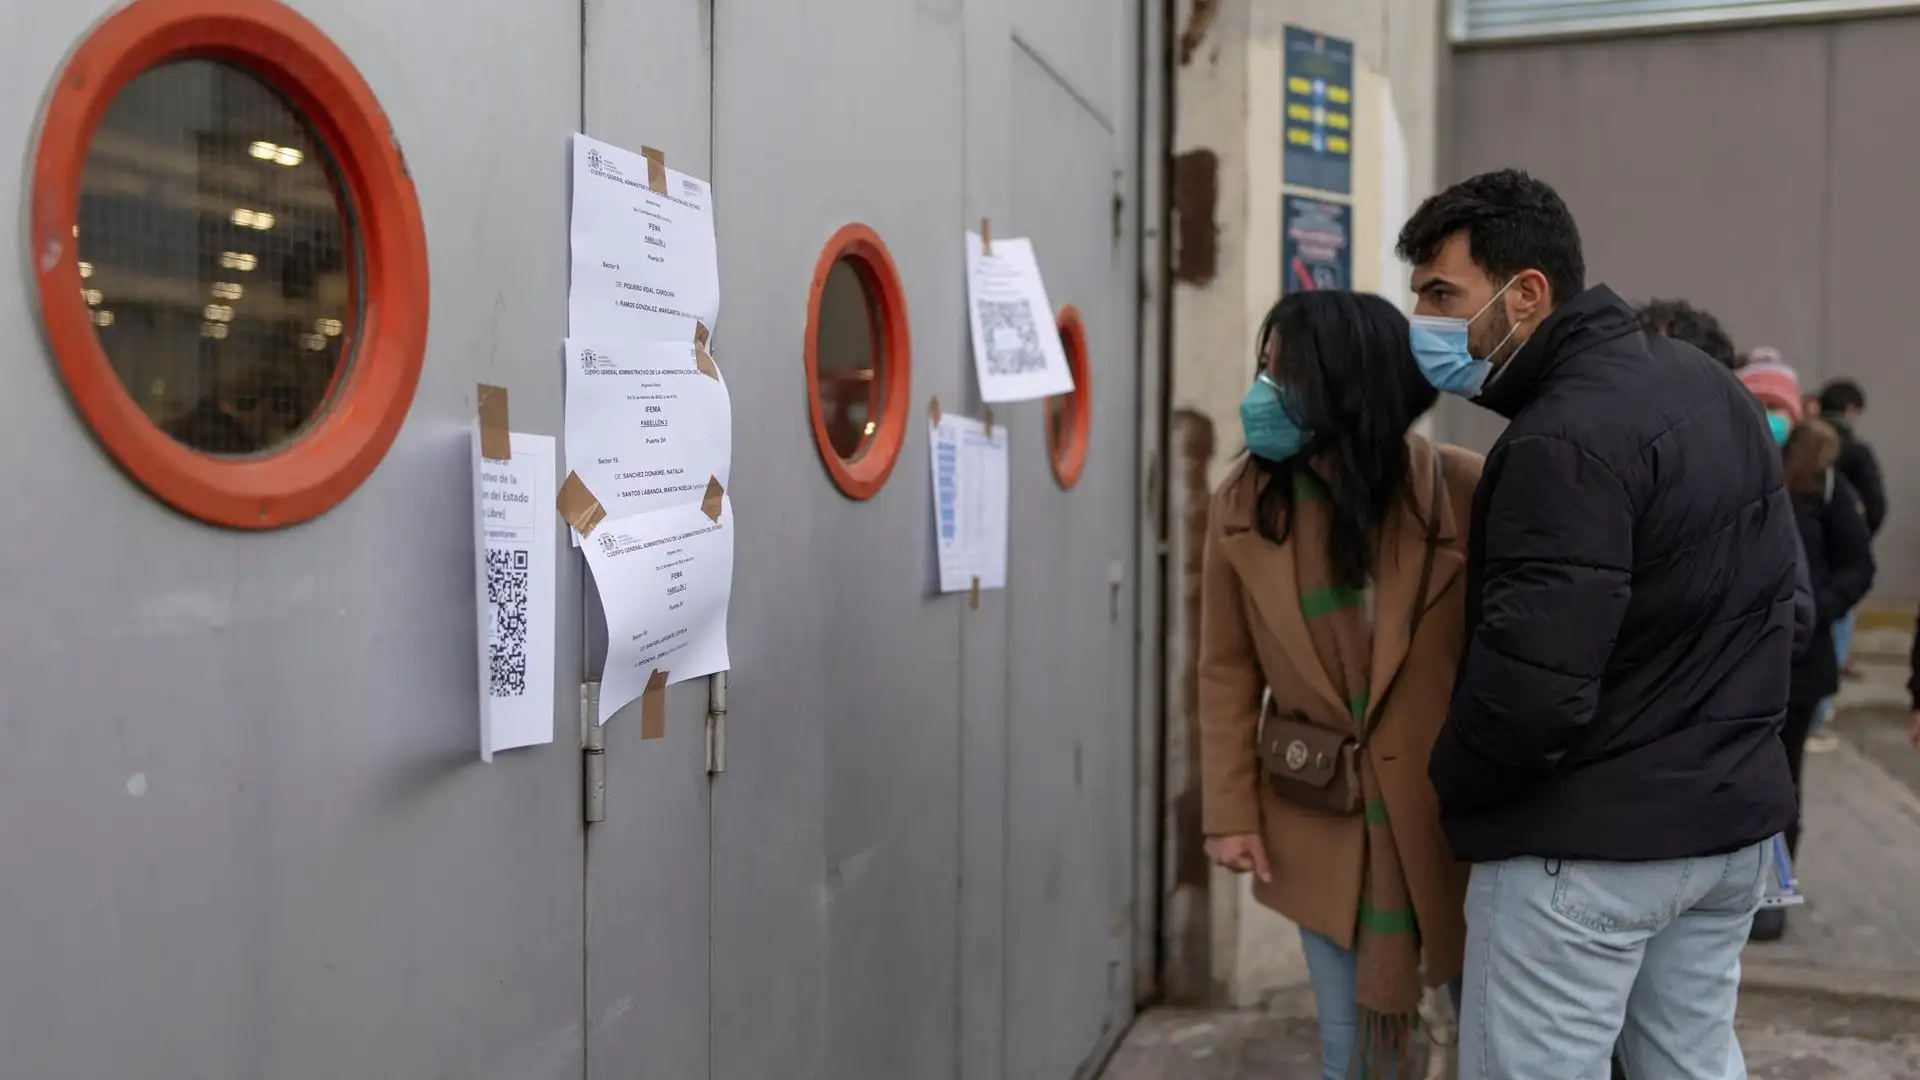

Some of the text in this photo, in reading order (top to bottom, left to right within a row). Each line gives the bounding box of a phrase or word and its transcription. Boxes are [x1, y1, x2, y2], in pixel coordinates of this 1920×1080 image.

[645, 405, 661, 413] IFEMA
[499, 474, 509, 484] de
[510, 474, 518, 485] la
[502, 491, 530, 503] Estado
